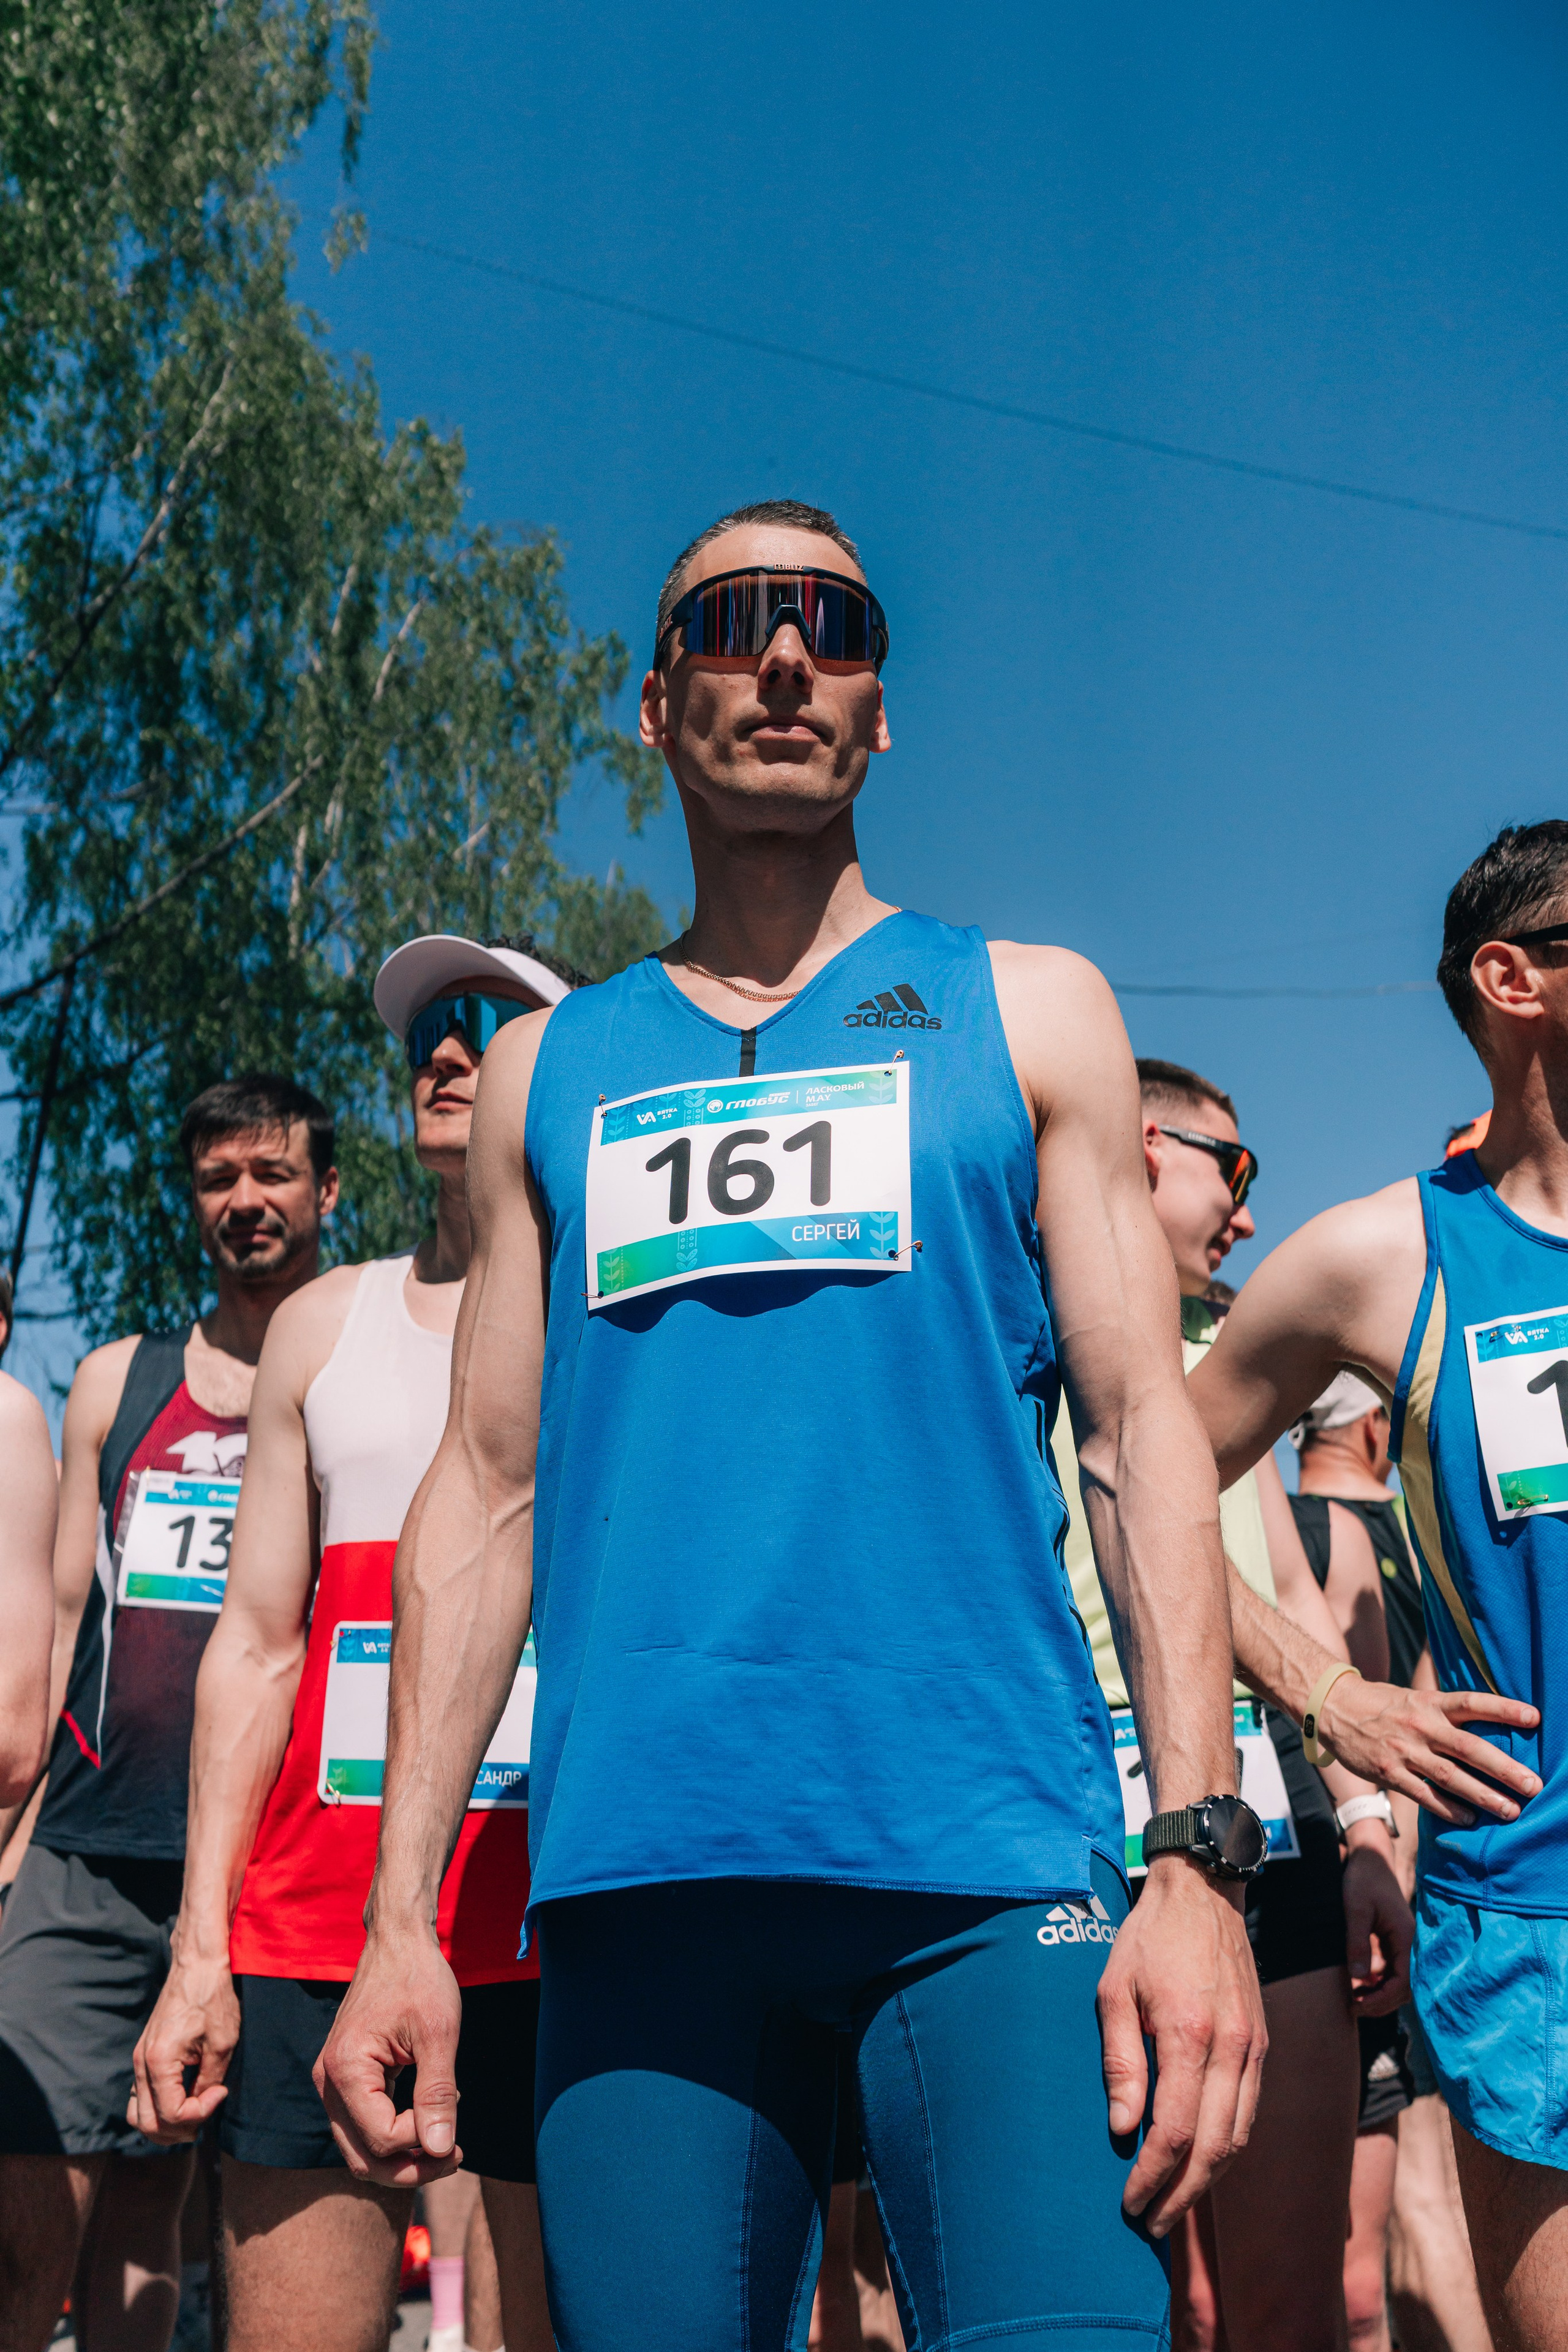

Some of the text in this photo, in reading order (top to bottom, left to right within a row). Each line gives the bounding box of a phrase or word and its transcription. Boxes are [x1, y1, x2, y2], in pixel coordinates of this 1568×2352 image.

[843, 1011, 942, 1030] adidas
[805, 1081, 865, 1095] ЛАСКОВЫЙ
[645, 1120, 832, 1224] 161
[791, 1219, 860, 1242] СЕРГЕЙ
